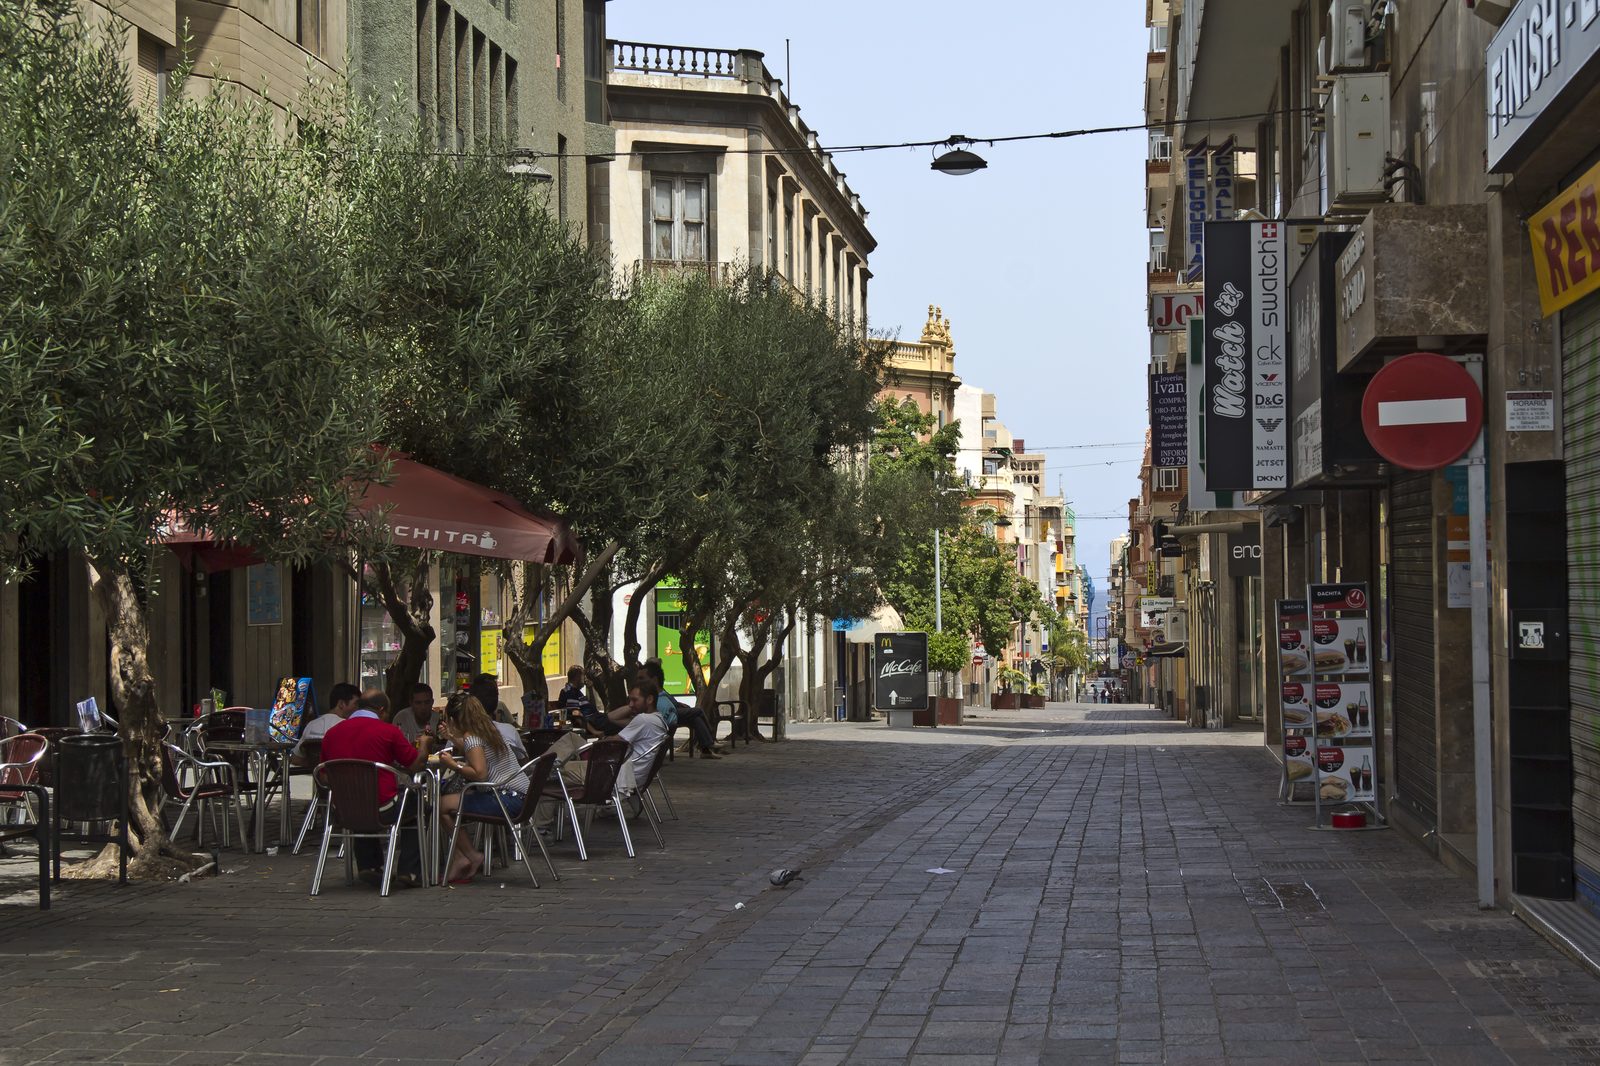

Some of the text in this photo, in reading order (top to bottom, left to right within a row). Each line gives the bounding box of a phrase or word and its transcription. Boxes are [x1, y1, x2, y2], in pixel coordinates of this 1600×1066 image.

[1491, 0, 1561, 139] FINISH
[1188, 157, 1206, 264] PELUQUERIA
[1258, 239, 1278, 327] swatch
[1213, 281, 1245, 419] Watch it!
[1255, 393, 1284, 406] D&G
[1160, 456, 1187, 466] 922 29
